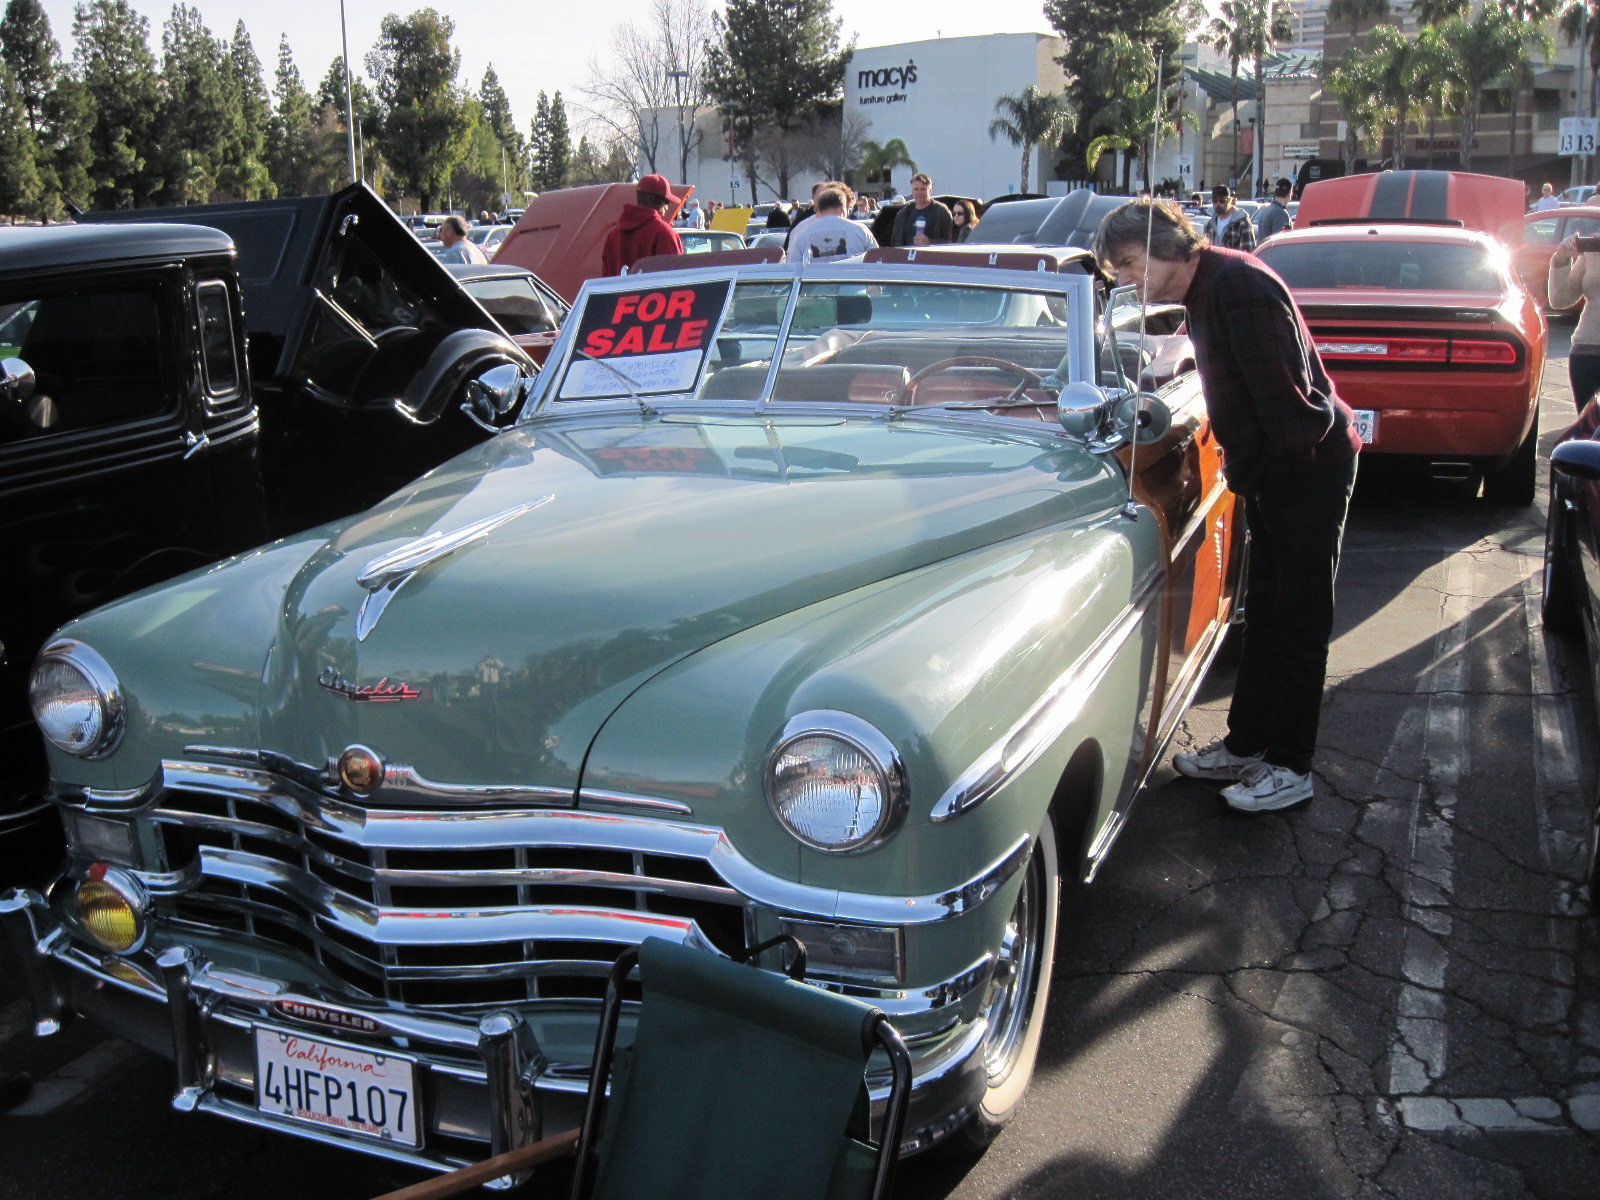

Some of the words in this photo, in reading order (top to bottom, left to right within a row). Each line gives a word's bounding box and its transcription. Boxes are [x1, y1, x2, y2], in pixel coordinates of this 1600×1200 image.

[858, 58, 917, 89] macy's
[860, 95, 885, 104] furniture
[886, 92, 907, 104] gallery
[1560, 135, 1573, 152] 13
[1576, 134, 1594, 152] 13
[1179, 164, 1191, 174] 14
[730, 180, 740, 188] 15
[611, 289, 696, 324] FOR
[583, 319, 709, 357] SALE
[282, 1002, 375, 1030] CHRYSLER
[286, 1038, 386, 1077] California
[265, 1061, 408, 1132] 4HFP107
